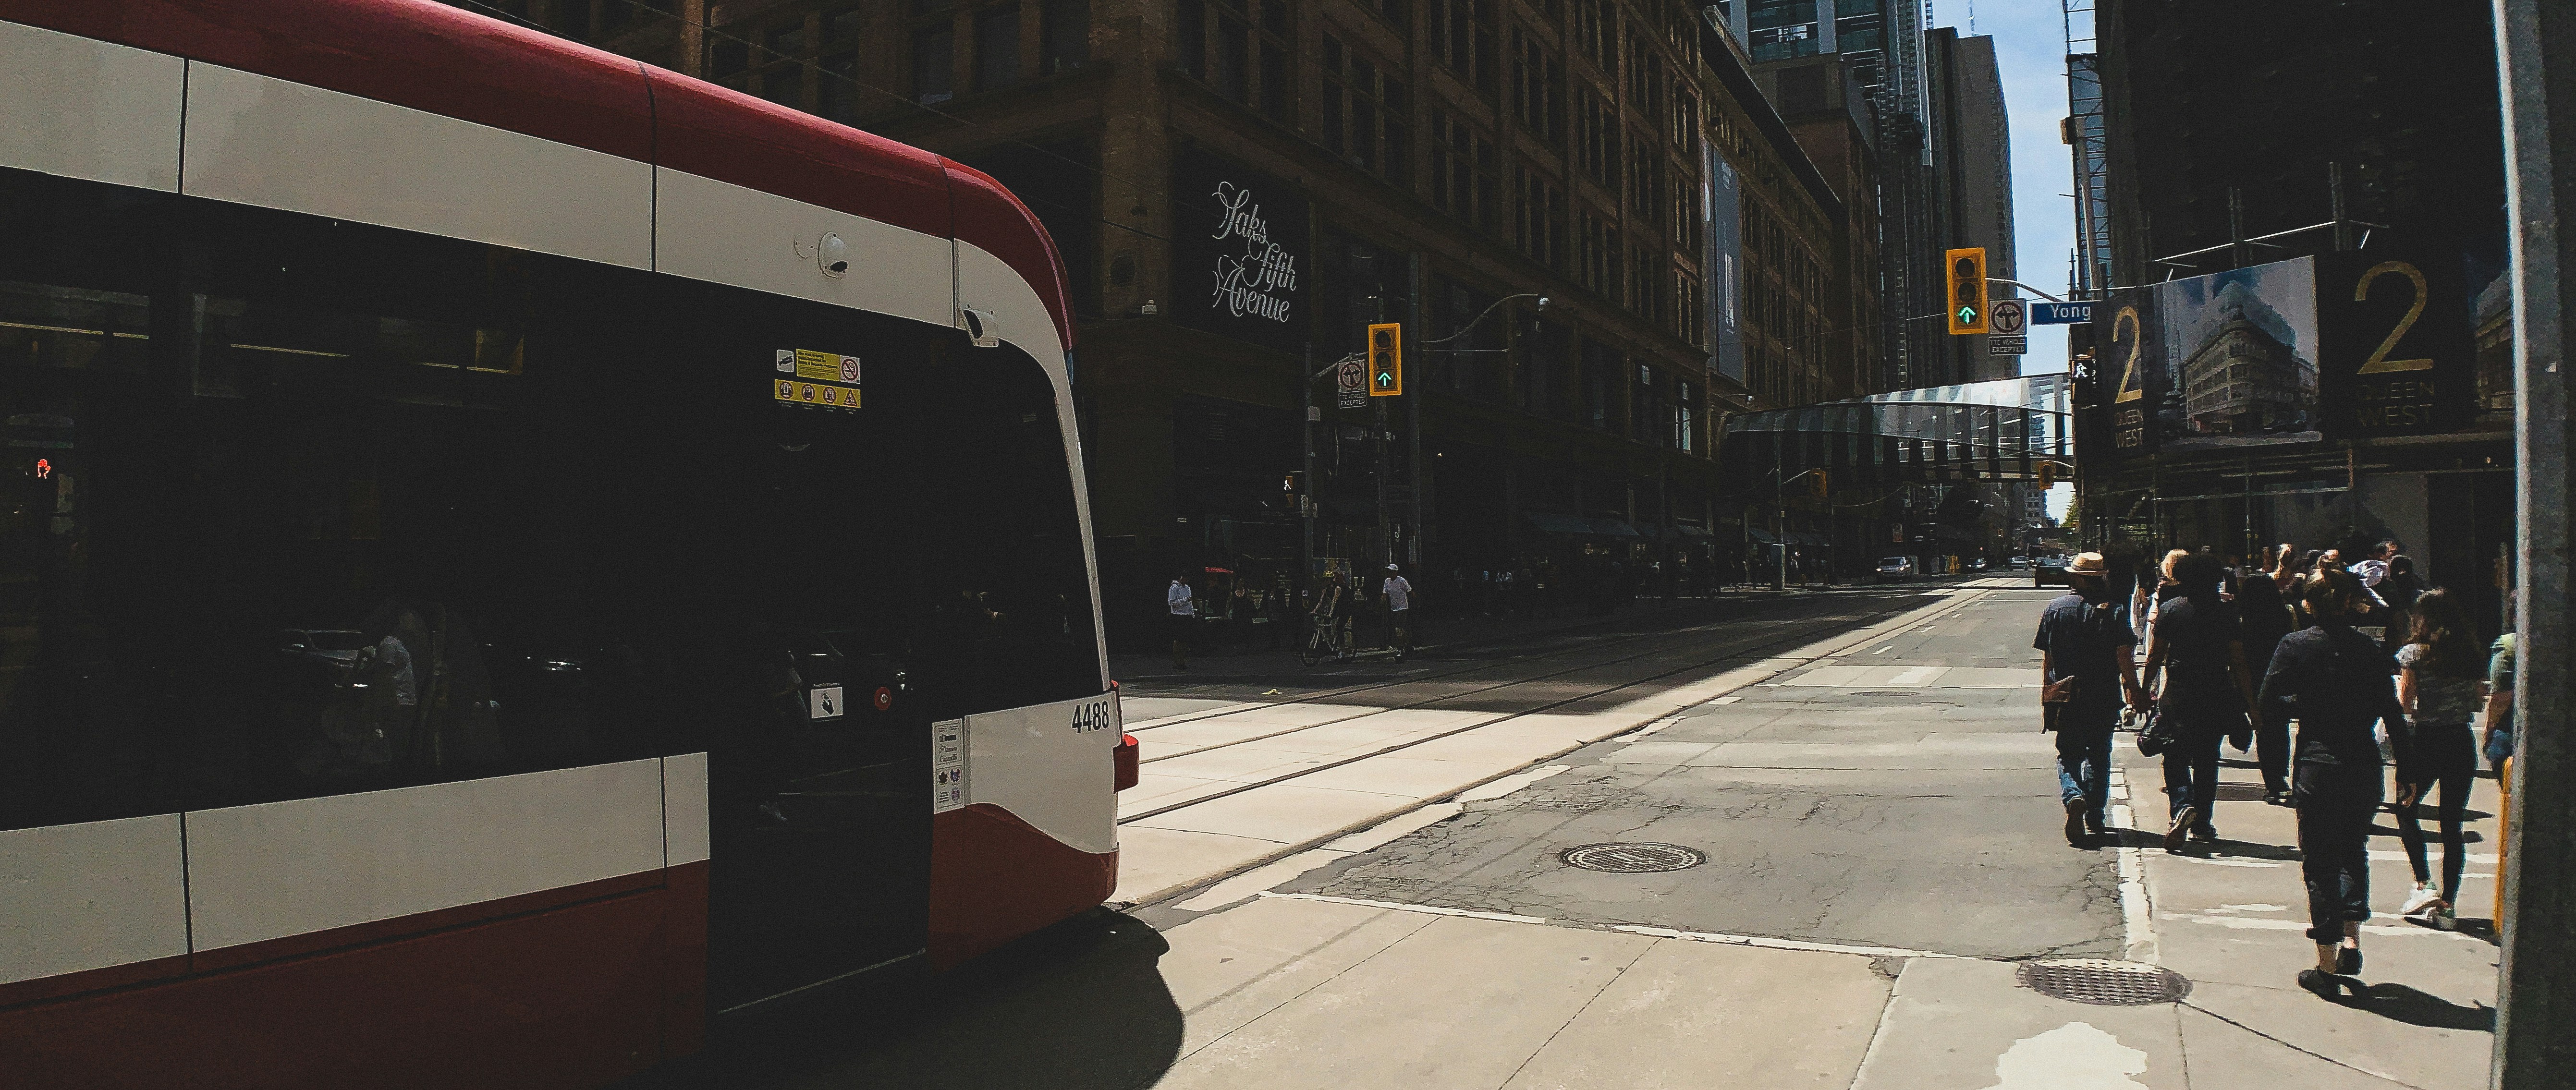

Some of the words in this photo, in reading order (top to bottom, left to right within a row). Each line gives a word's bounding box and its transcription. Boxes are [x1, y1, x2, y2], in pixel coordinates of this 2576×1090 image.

[1212, 181, 1266, 244] Saks
[1241, 233, 1296, 292] Fifth
[1212, 254, 1289, 322] Avenue
[2050, 303, 2091, 321] Yong
[2354, 261, 2434, 375] 2
[2113, 305, 2143, 404] 2
[2355, 381, 2435, 401] QUEEN
[2115, 427, 2144, 448] WEST
[2355, 403, 2435, 427] WEST
[1072, 701, 1110, 733] 4488
